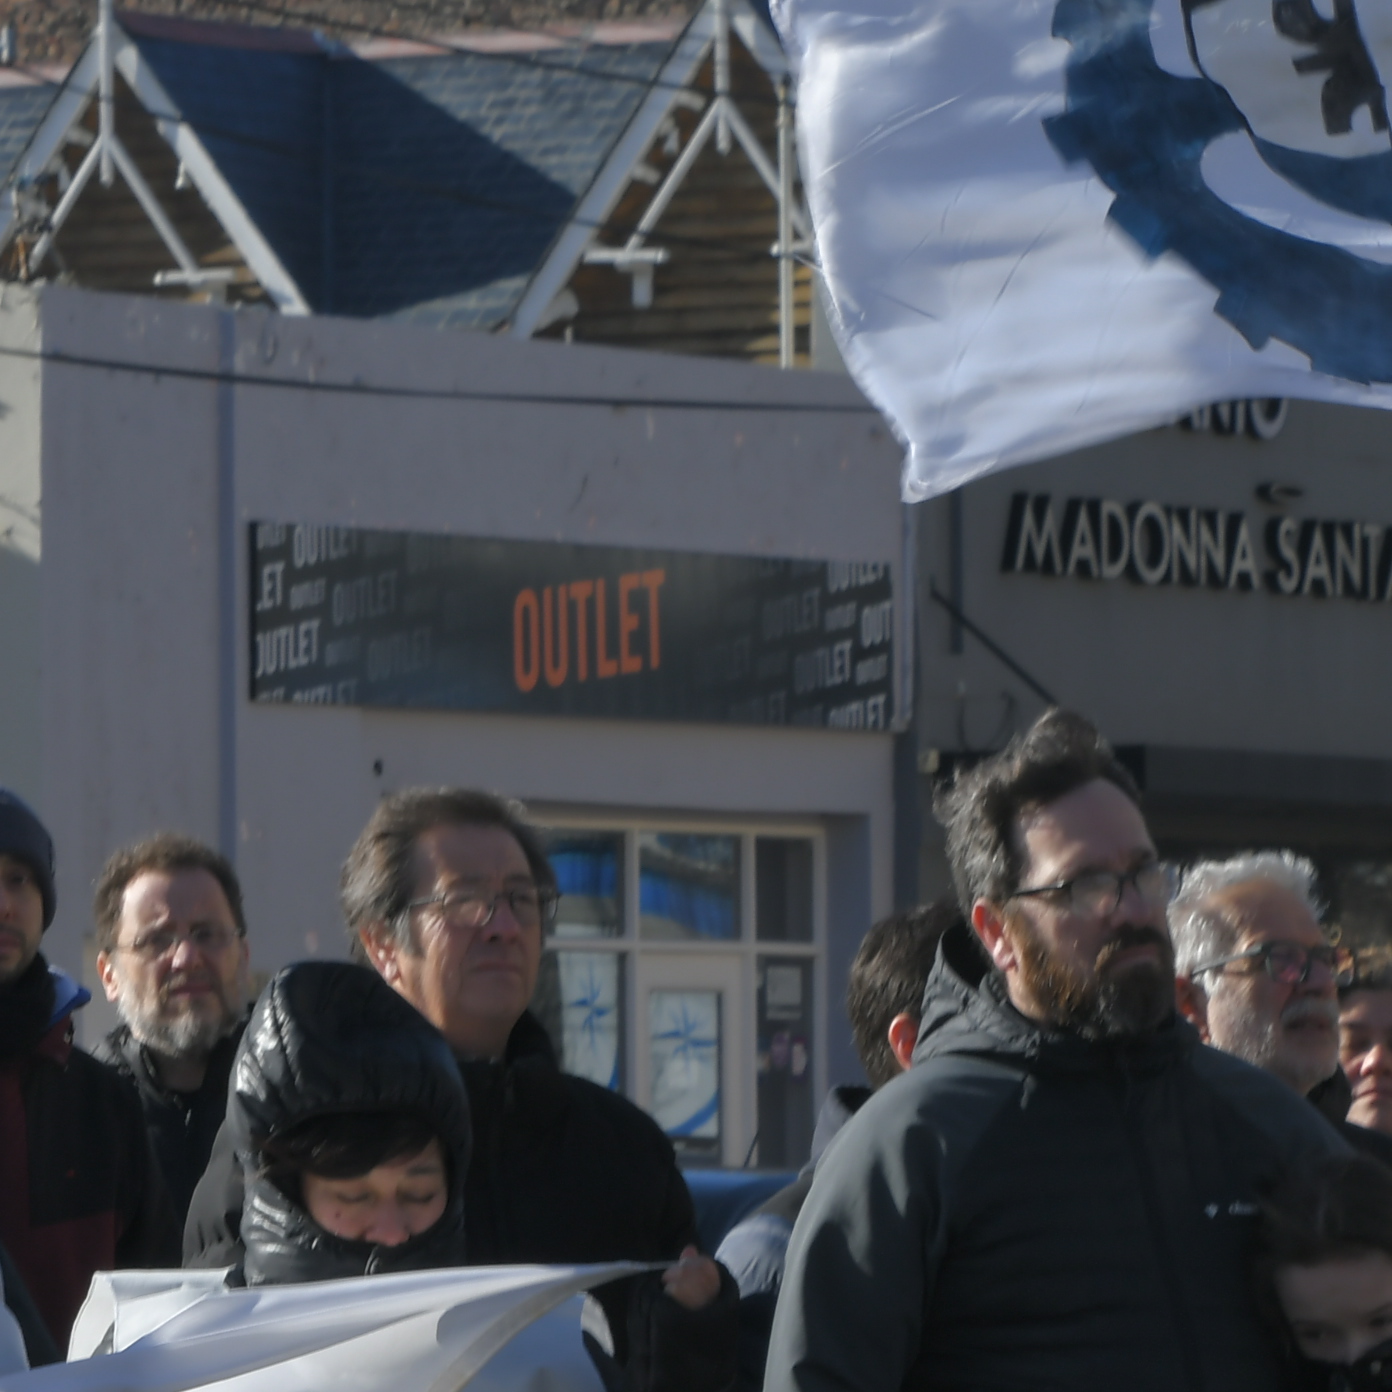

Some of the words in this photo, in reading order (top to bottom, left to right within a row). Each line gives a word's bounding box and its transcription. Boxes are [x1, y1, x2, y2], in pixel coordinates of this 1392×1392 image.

[1016, 500, 1262, 590] MADONNA
[1276, 514, 1392, 602] SANT
[515, 569, 666, 693] OUTLET
